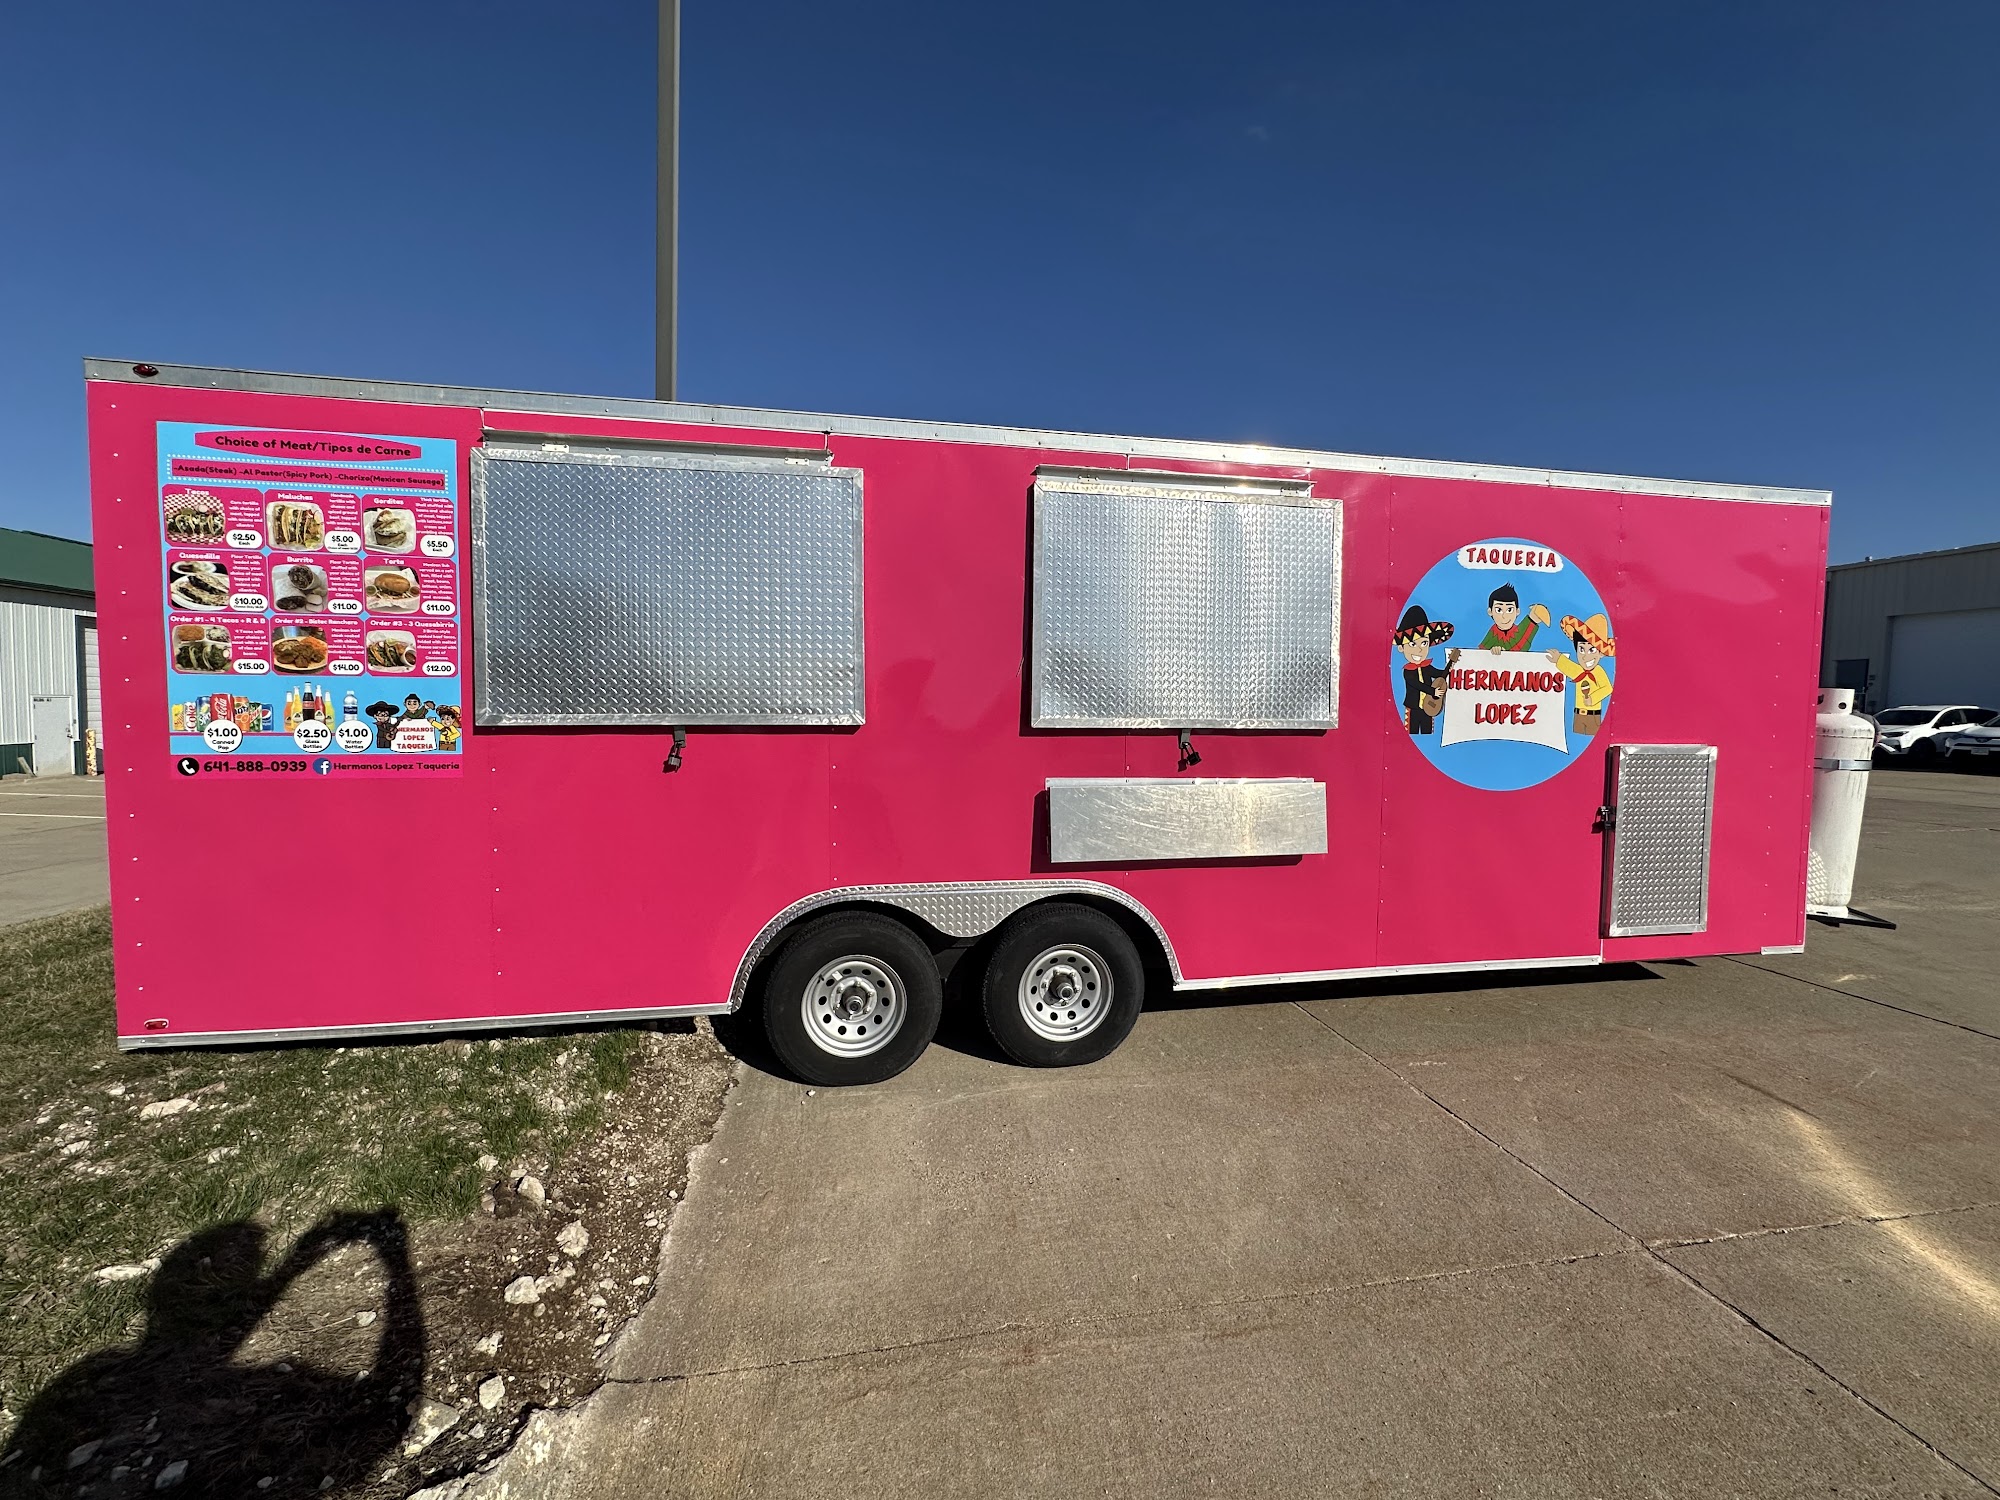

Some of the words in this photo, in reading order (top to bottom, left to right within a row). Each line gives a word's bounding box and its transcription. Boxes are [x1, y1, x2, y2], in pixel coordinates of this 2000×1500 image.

[215, 435, 259, 448] Choice
[262, 439, 277, 449] of
[280, 440, 353, 455] Meat/Tipos
[357, 444, 372, 454] de
[374, 445, 411, 456] Carne
[309, 472, 333, 481] Pork)
[373, 497, 404, 505] Gorditas
[232, 533, 256, 541] $2.50
[331, 535, 354, 543] $5.00
[426, 540, 448, 548] $5.50
[179, 552, 221, 560] Quesadilla
[1466, 547, 1557, 568] TAQUERIA
[234, 597, 263, 605] $10.00
[332, 602, 358, 610] $11.00
[426, 604, 451, 612] $11.00
[237, 662, 265, 670] $15.00
[426, 664, 452, 672] $12.00
[1449, 668, 1565, 693] HERMANOS
[1474, 703, 1538, 725] LOPEZ
[207, 728, 238, 738] $1.00
[296, 728, 328, 738] $2.50
[338, 728, 368, 738] $1.00
[203, 761, 307, 772] 641-888-0939
[385, 763, 414, 771] Lopez
[416, 762, 460, 771] Taqueria
